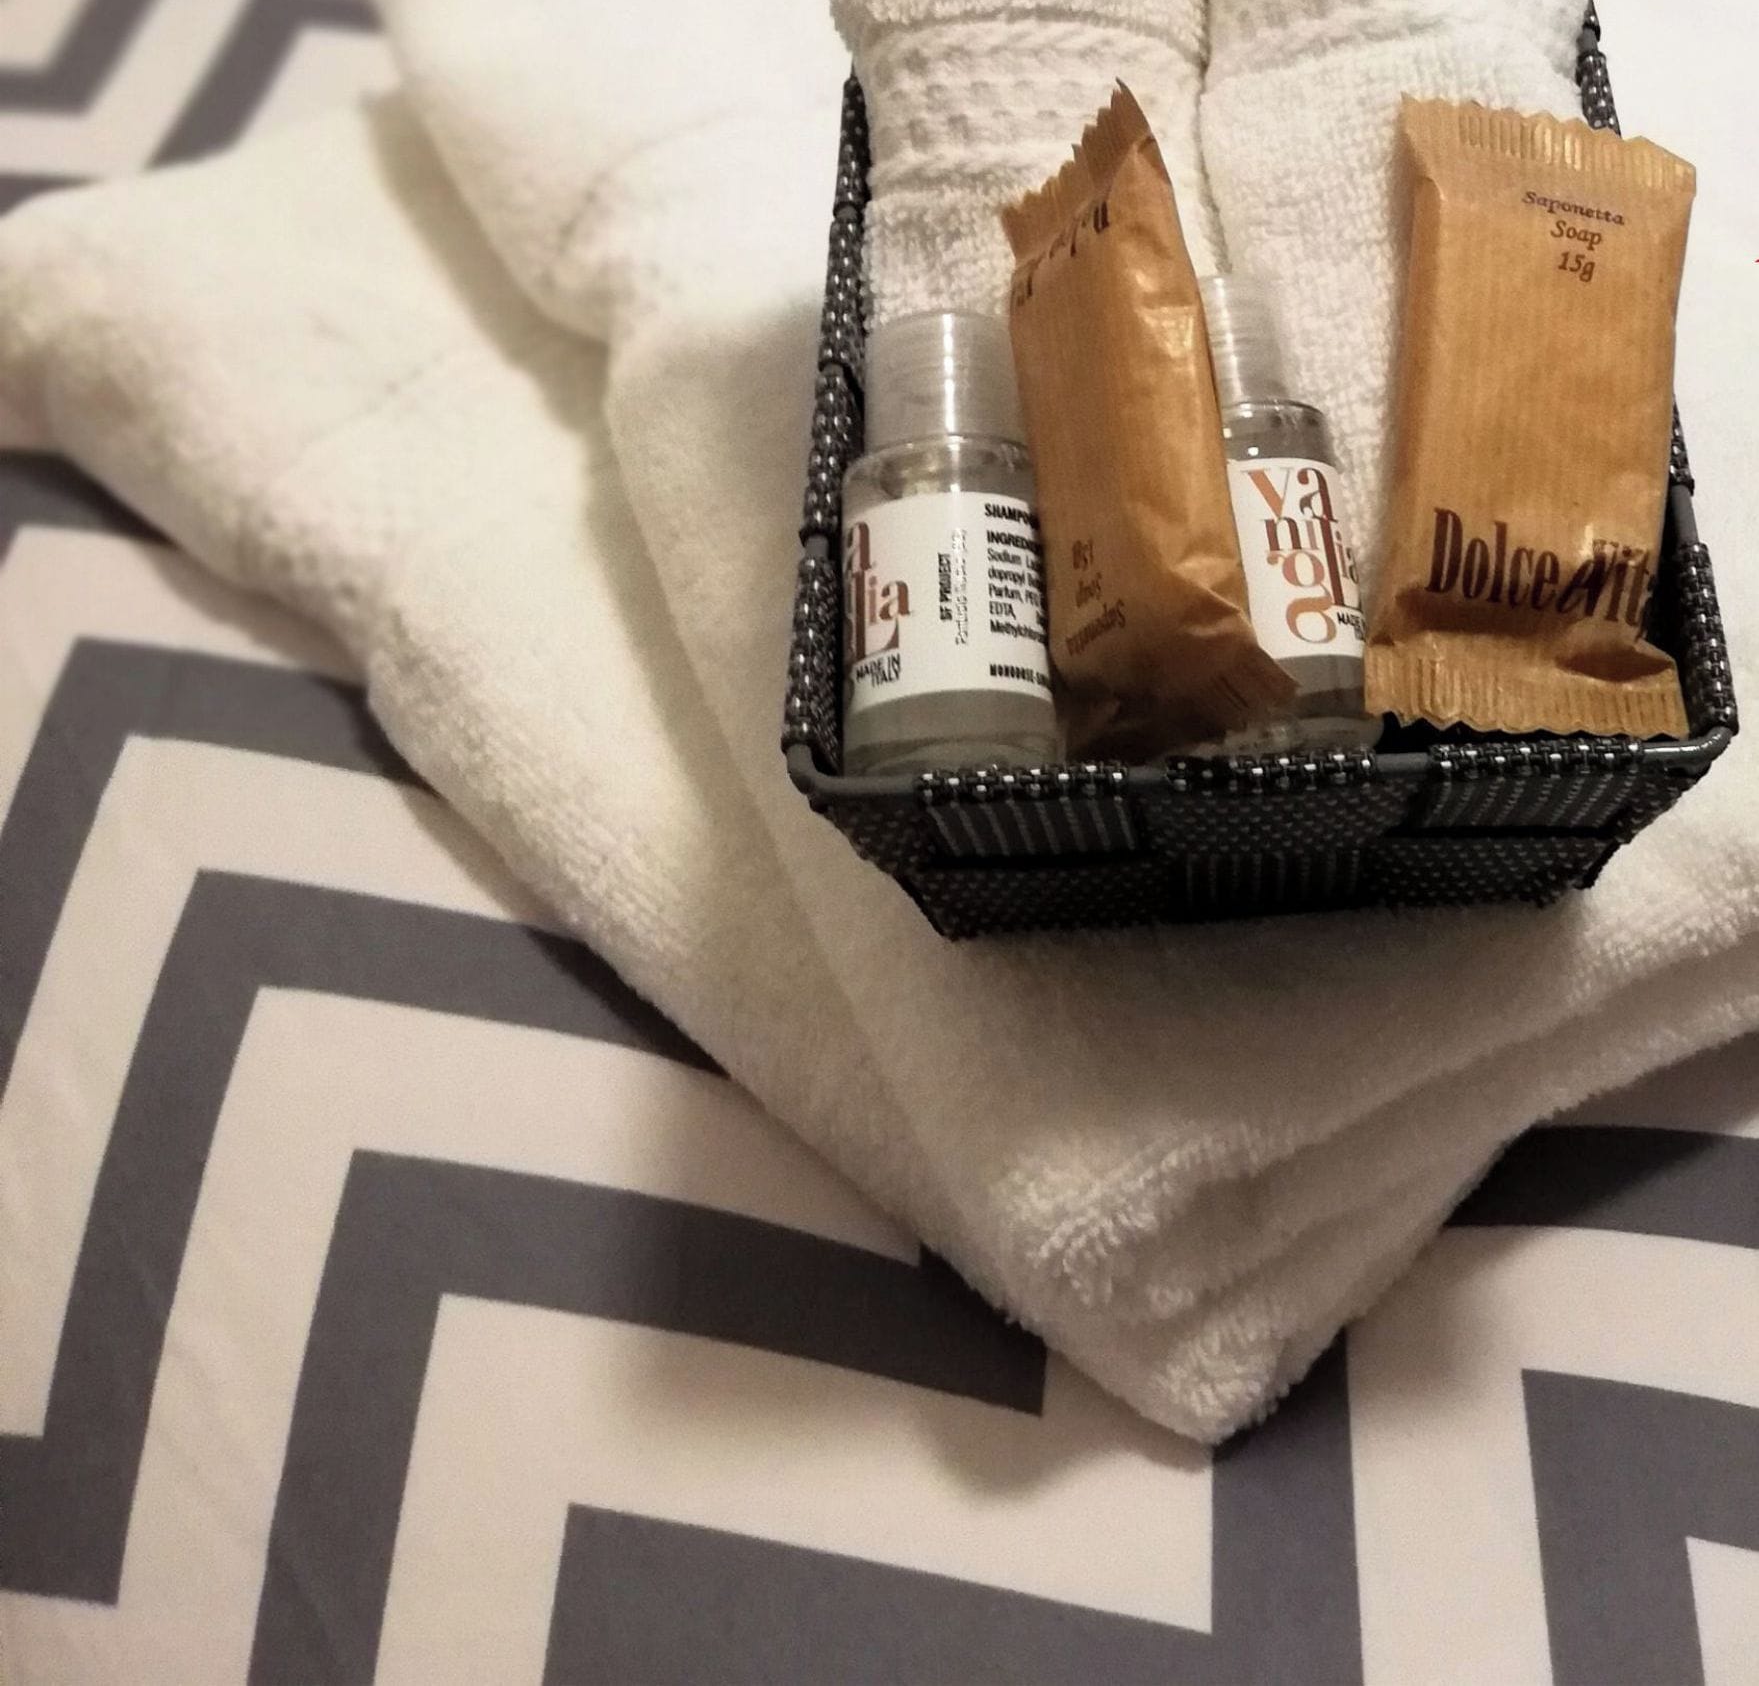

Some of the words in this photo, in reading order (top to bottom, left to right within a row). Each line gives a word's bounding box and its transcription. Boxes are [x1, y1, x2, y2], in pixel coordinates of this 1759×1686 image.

[1521, 191, 1625, 225] Saponetta
[1550, 219, 1602, 251] Soap
[1558, 252, 1595, 283] 15g
[1425, 507, 1560, 611] Dolce
